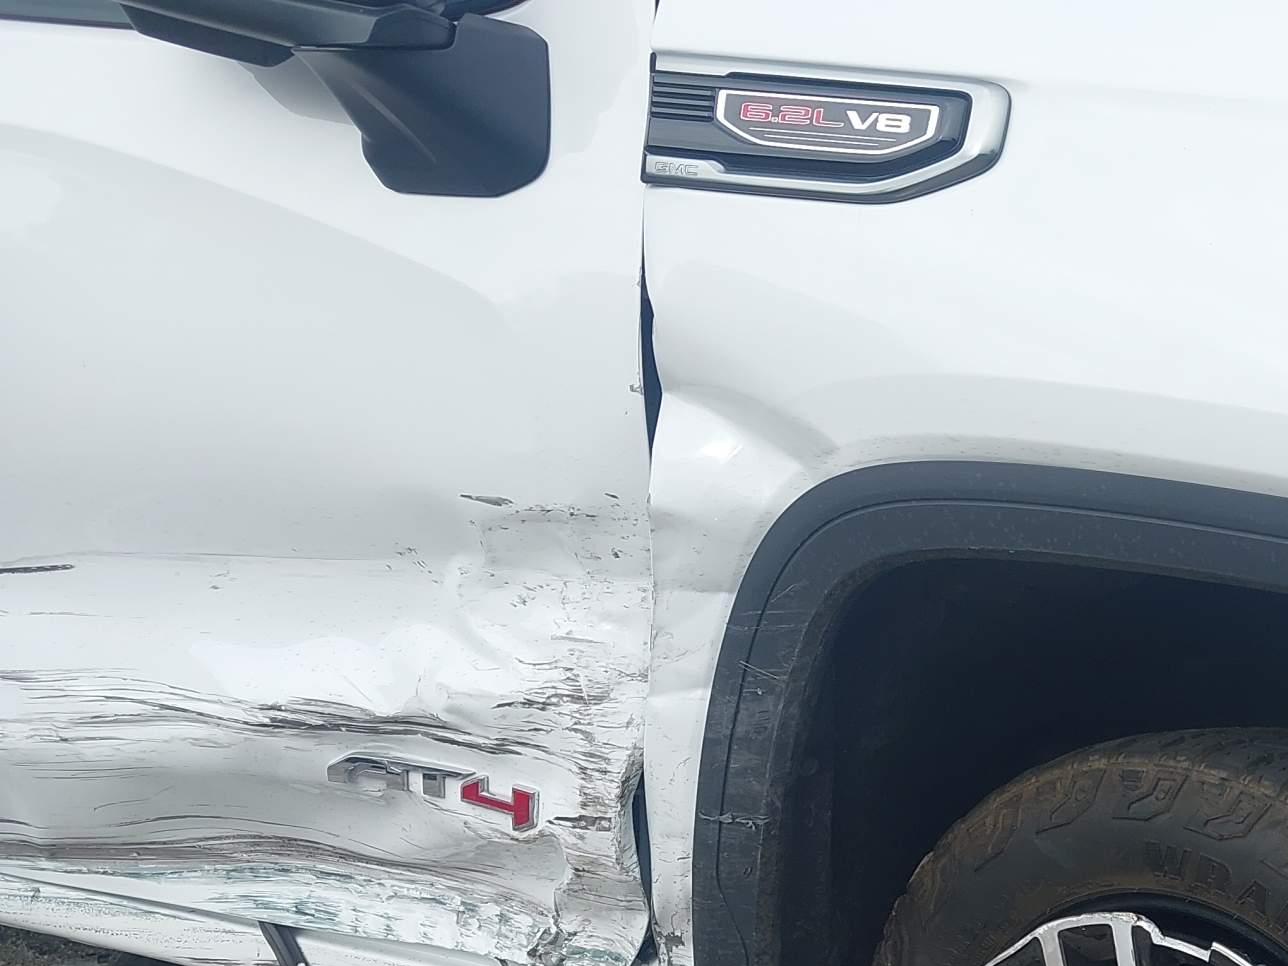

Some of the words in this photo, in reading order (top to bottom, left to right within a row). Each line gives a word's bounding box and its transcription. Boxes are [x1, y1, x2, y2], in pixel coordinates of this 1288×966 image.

[739, 101, 844, 128] 6.2L
[845, 109, 912, 134] V8
[653, 160, 699, 177] GMC
